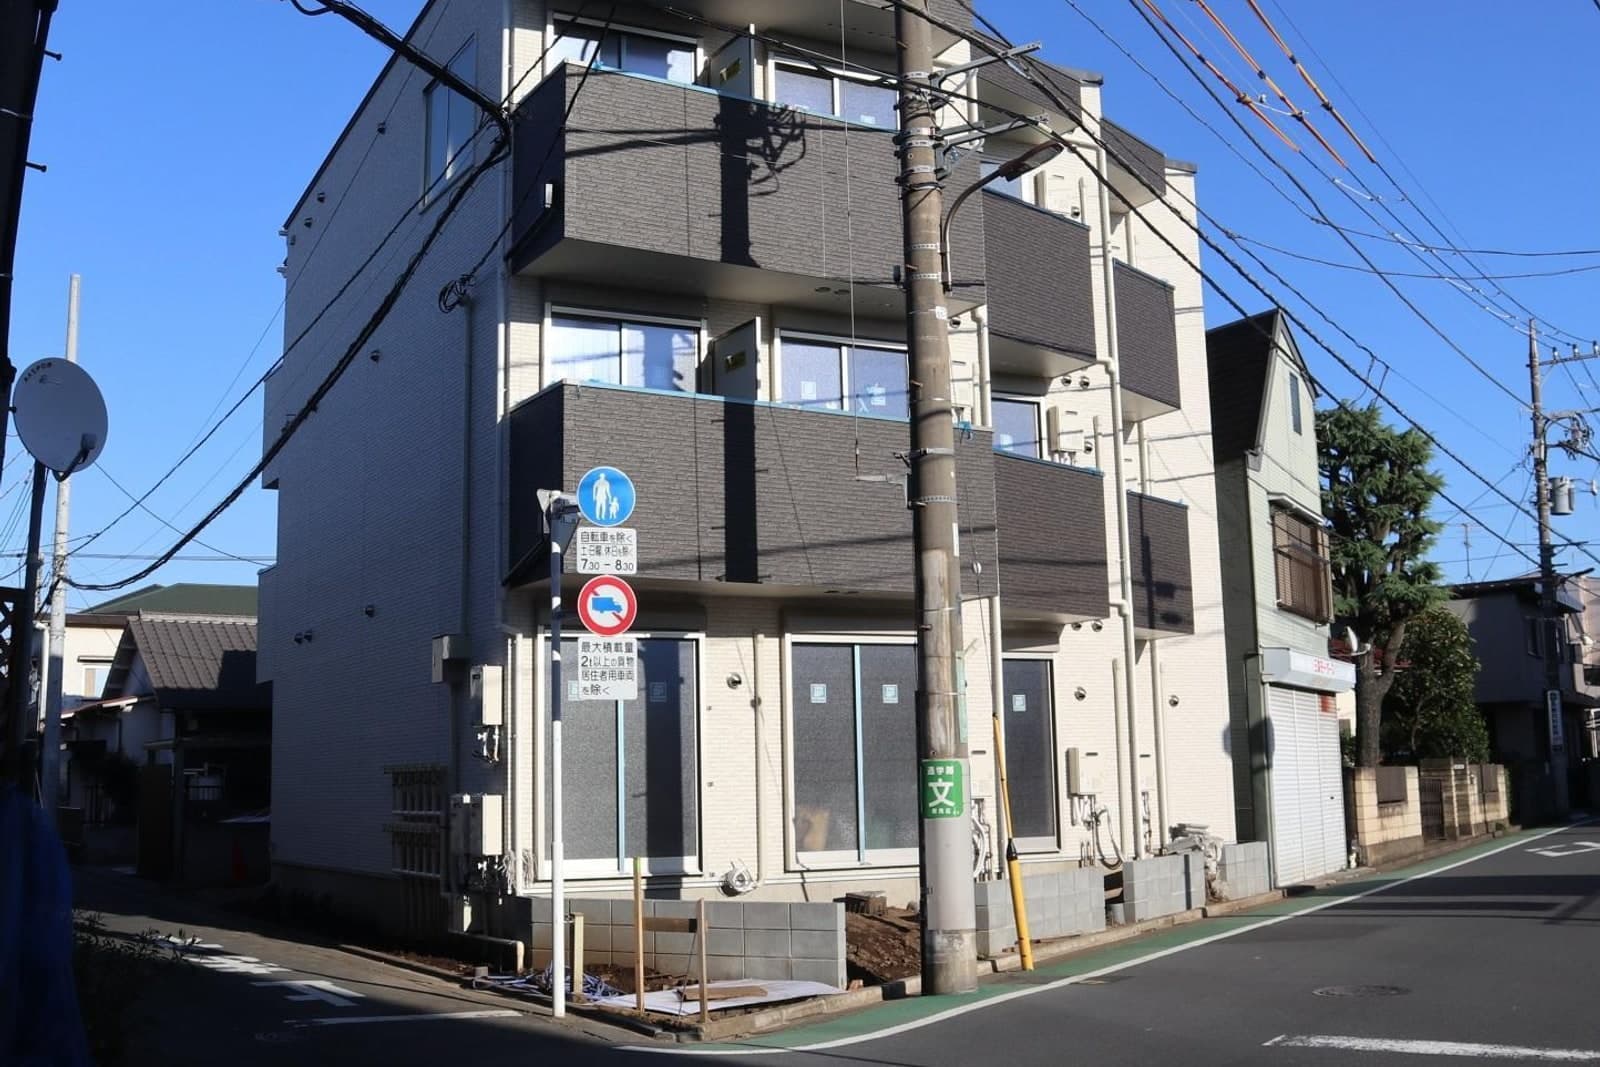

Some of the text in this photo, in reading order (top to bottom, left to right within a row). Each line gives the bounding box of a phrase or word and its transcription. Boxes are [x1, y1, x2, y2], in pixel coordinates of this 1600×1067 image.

[581, 531, 632, 542] 自転車を除く
[581, 641, 633, 653] 最大積載量
[582, 684, 611, 695] を除く
[928, 778, 956, 808] 文
